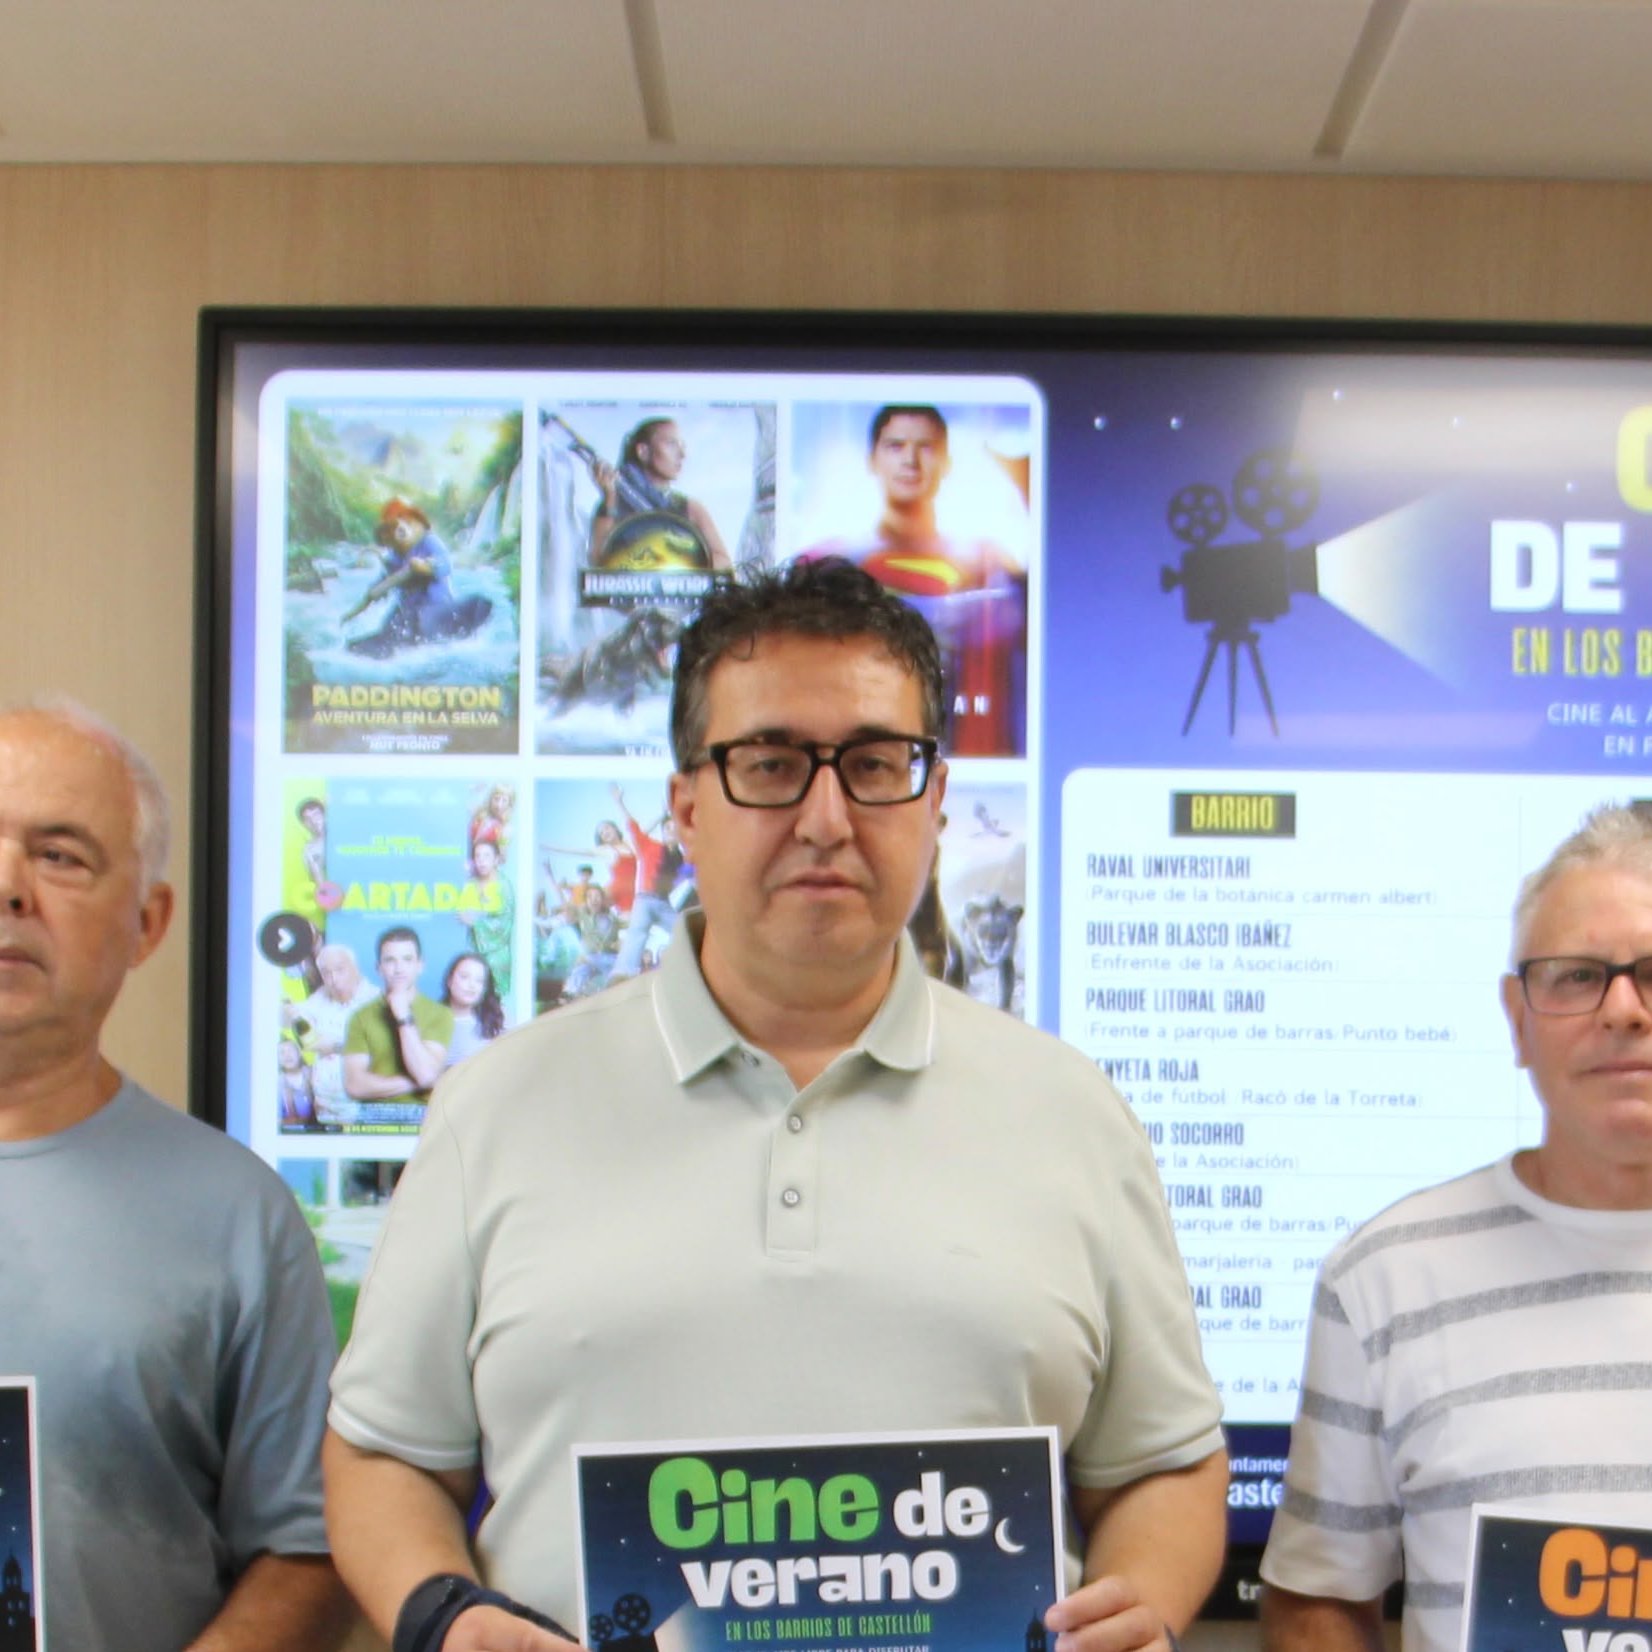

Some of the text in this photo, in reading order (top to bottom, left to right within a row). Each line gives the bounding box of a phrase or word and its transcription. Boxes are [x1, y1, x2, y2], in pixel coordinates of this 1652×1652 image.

[1488, 518, 1623, 614] DE
[1513, 627, 1550, 675] EN
[1564, 629, 1620, 678] LOS
[313, 710, 499, 725] AVENTURA EN LA SELVA
[1549, 701, 1601, 726] CINE
[1612, 702, 1639, 726] AL
[1604, 735, 1637, 758] EN
[1191, 796, 1273, 830] BARRIO
[1088, 855, 1251, 879] RAVAL UNIVERSITARI
[1087, 922, 1158, 946] BULEVAR
[1166, 923, 1228, 947] BLASCO
[1087, 989, 1264, 1013] PARQUE LITORAL GRAO
[1159, 1059, 1199, 1082] ROJA
[1171, 1123, 1244, 1145] SOCORRO
[649, 1457, 989, 1549] Cine de
[681, 1550, 957, 1608] verano
[726, 1610, 931, 1640] EN LOS BARRIOS DE CASTELLÓN
